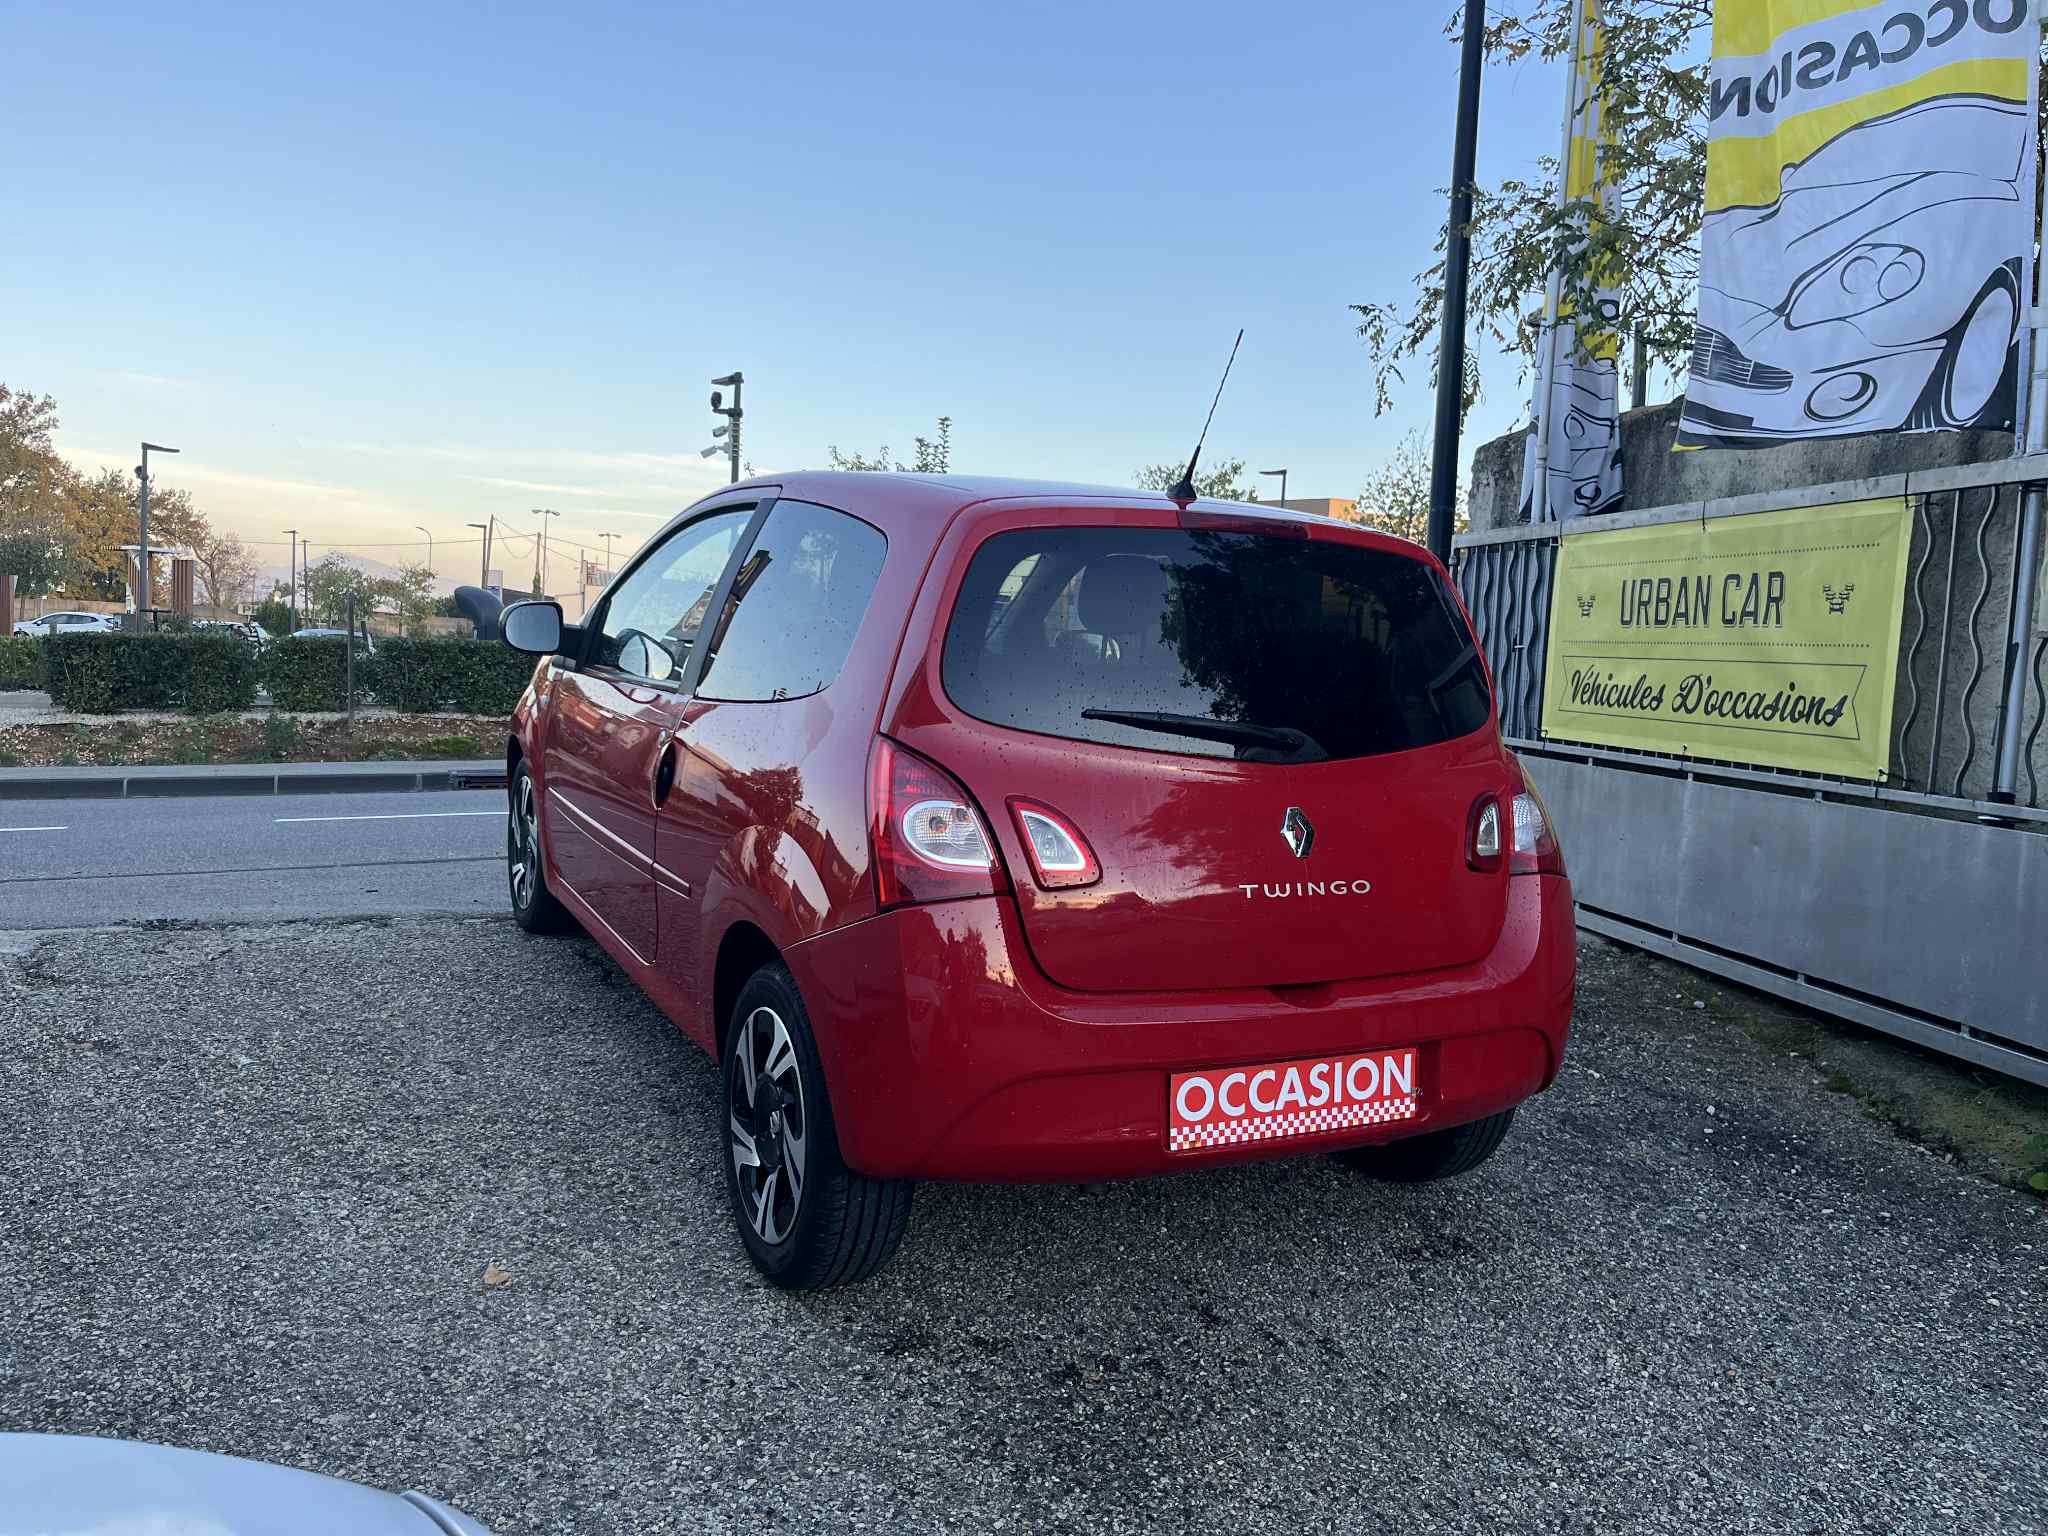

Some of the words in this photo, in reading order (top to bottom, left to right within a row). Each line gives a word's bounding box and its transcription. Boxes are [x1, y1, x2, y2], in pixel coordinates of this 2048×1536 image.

[1620, 574, 1713, 628] URBAN
[1721, 571, 1786, 628] CAR
[1571, 664, 1667, 711] Véhicules
[1671, 674, 1848, 727] D'occasions
[1238, 879, 1372, 899] TWINGO
[1175, 1053, 1412, 1122] OCCASION
